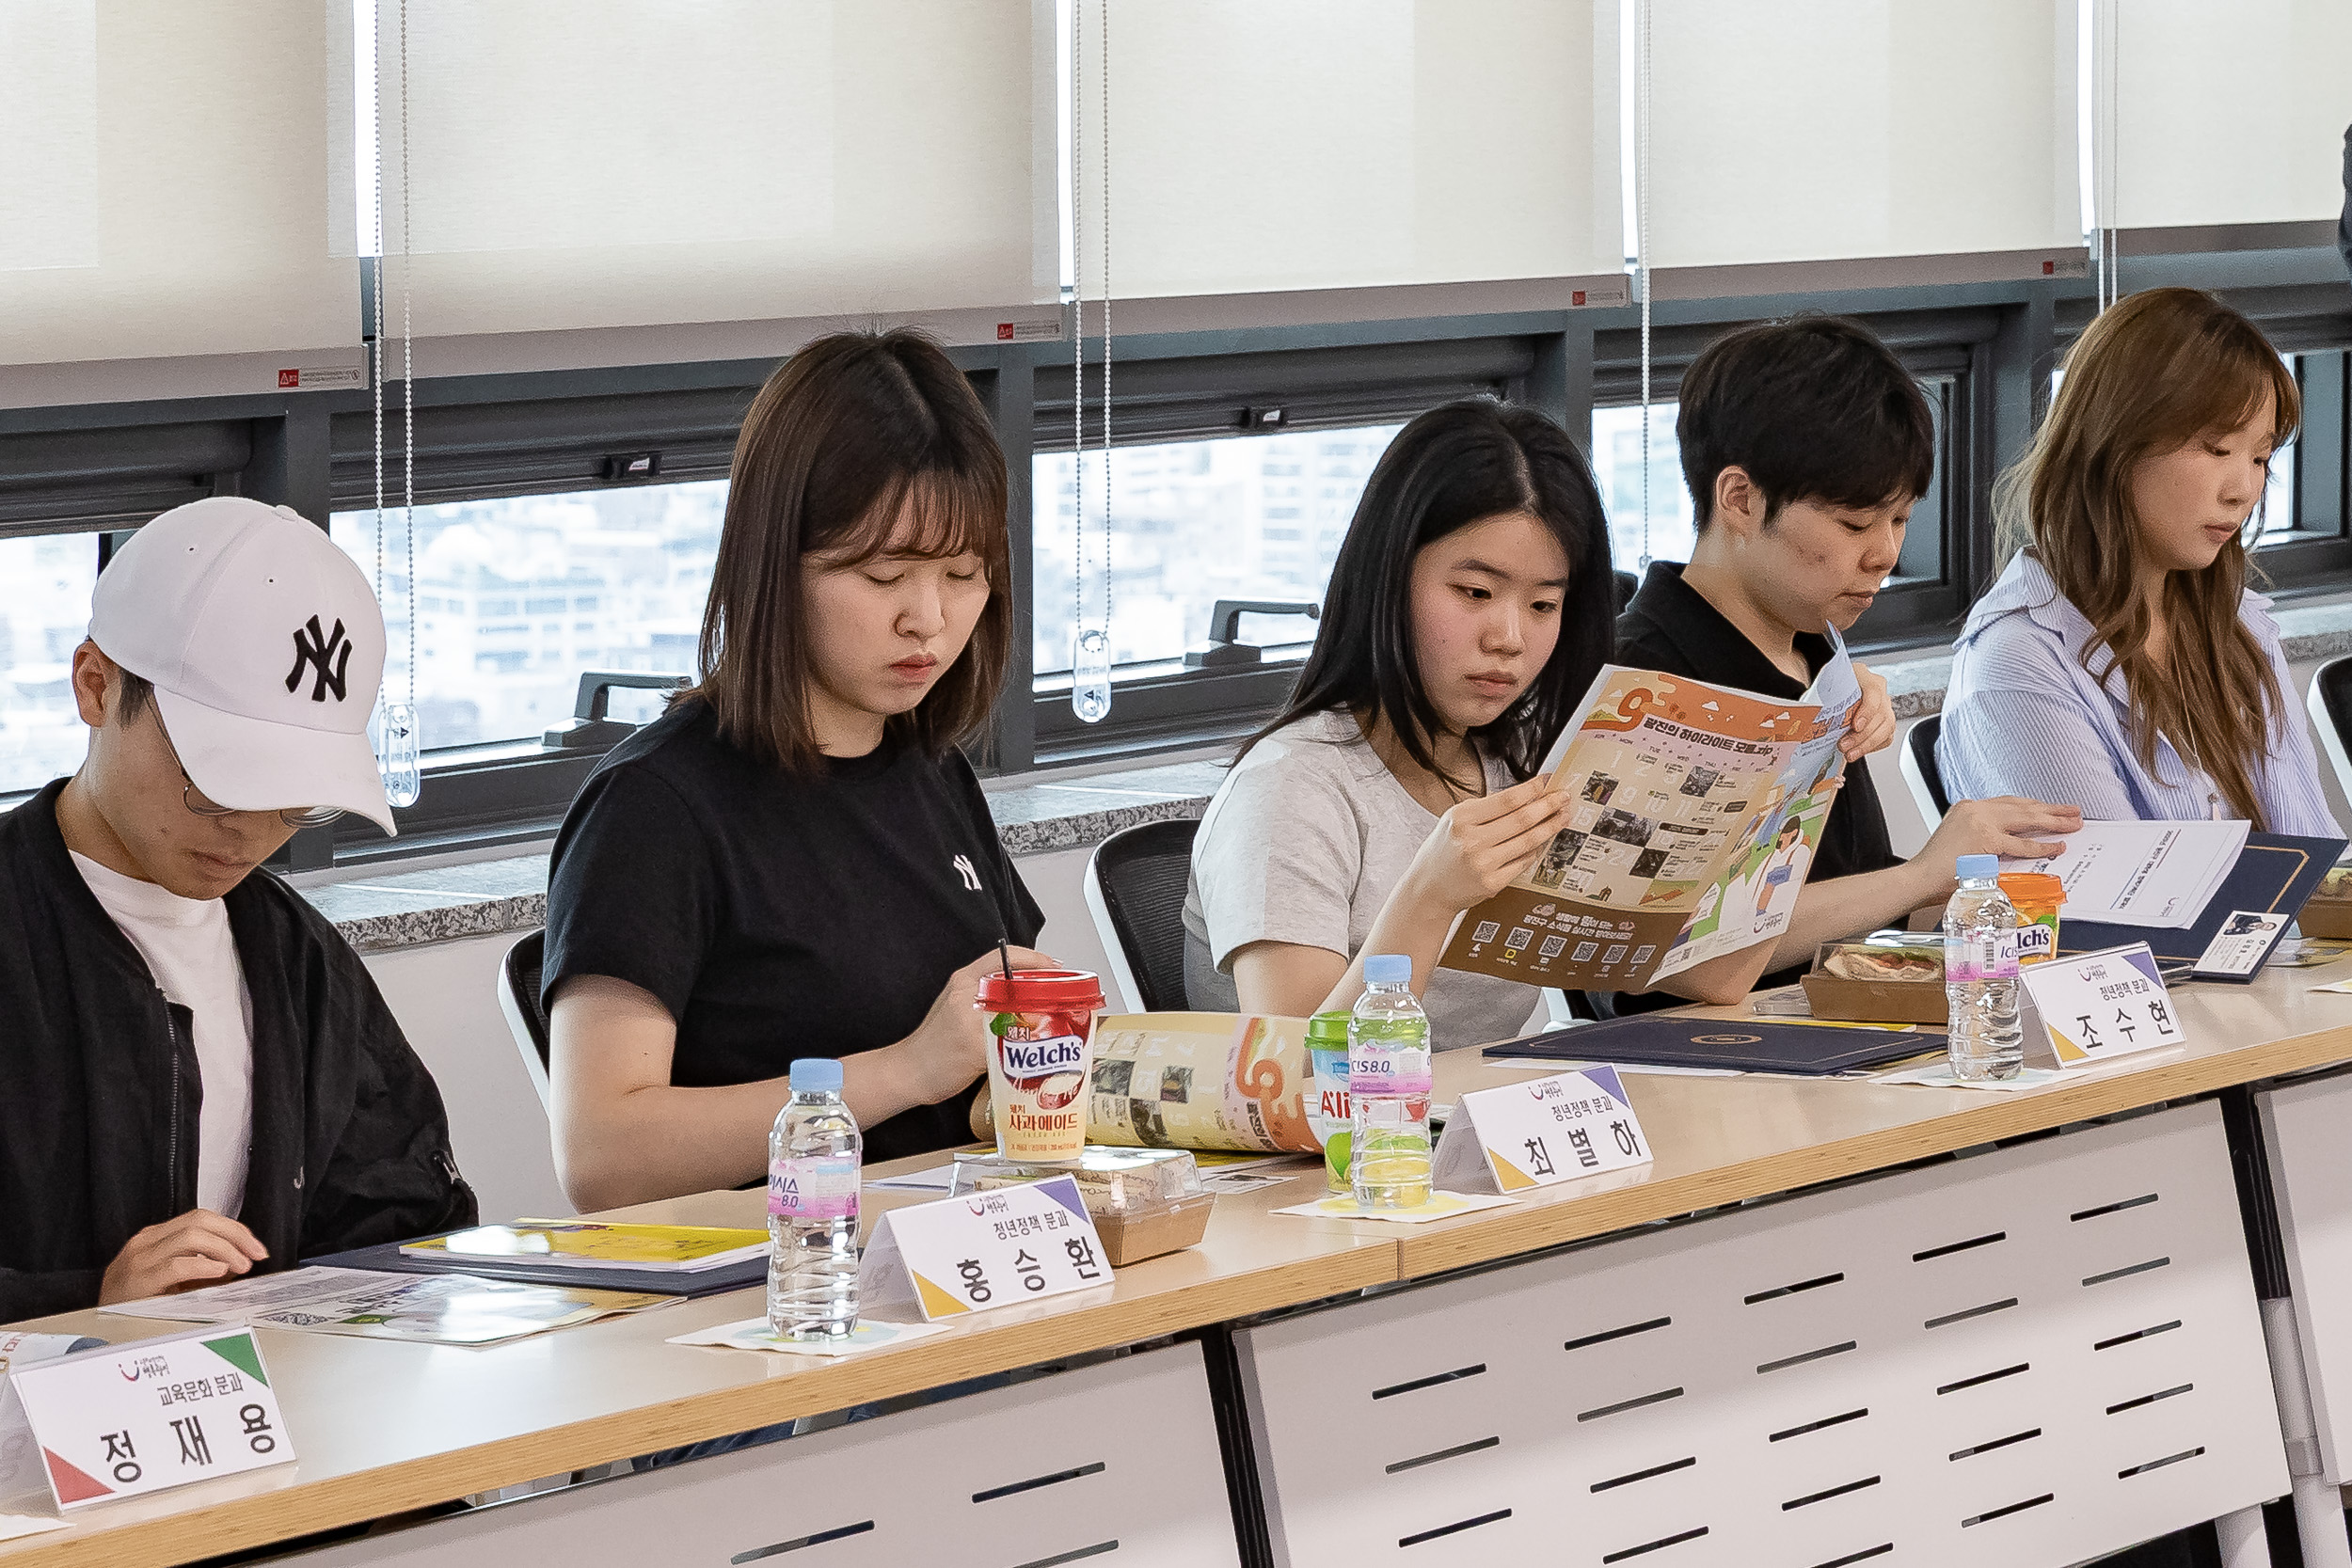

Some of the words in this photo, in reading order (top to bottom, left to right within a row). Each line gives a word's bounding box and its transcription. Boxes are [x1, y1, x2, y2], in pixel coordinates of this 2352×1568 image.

[285, 613, 353, 703] NY
[1678, 728, 1735, 752] 하이라이트
[2017, 928, 2049, 949] lch's
[2099, 981, 2133, 1002] 청년정책
[2131, 978, 2151, 994] 분과
[2076, 1015, 2104, 1049] 조
[2116, 1007, 2136, 1042] 수
[2148, 999, 2174, 1036] 현
[1005, 1041, 1081, 1069] Welch's
[1321, 1090, 1350, 1118] A'li
[1551, 1100, 1593, 1122] 청년정책
[1592, 1095, 1613, 1113] 분과
[1009, 1113, 1078, 1132] 사과에이드
[1524, 1136, 1556, 1176] 최
[1567, 1128, 1599, 1168] 별
[1610, 1119, 1642, 1157] 하
[769, 1174, 799, 1194] 이시스
[782, 1195, 799, 1208] 8.0
[993, 1216, 1043, 1241] 청년정책
[1043, 1210, 1070, 1228] 분과
[956, 1259, 992, 1303] 홍
[1014, 1249, 1046, 1291] 승
[1064, 1236, 1101, 1280] 환
[156, 1378, 215, 1406] 교육문화
[216, 1372, 244, 1397] 분과
[100, 1429, 142, 1483] 정
[169, 1415, 214, 1466] 재
[239, 1403, 276, 1454] 용
